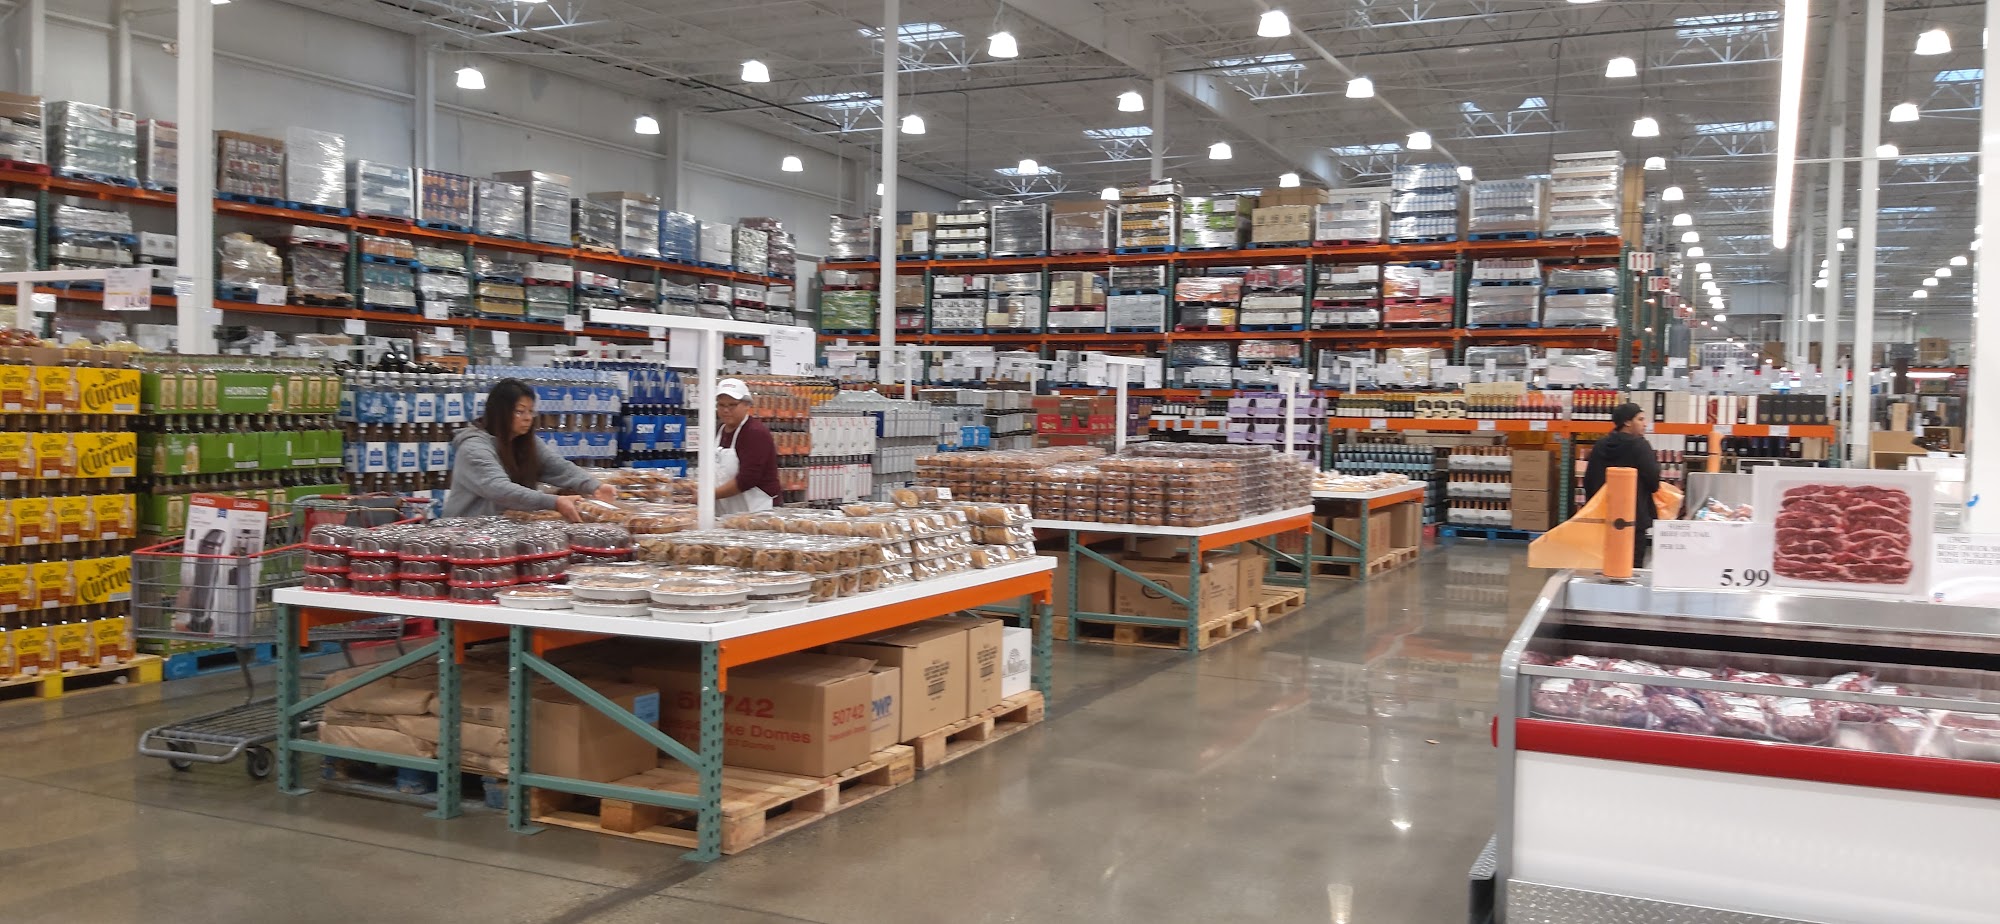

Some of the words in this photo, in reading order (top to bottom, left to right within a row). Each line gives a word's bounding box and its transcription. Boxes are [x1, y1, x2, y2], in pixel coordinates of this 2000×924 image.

[1632, 254, 1652, 268] 111
[796, 362, 816, 375] 7.99
[225, 386, 268, 396] HORNITOS
[1720, 568, 1771, 587] 5.99
[831, 703, 865, 727] 50742
[751, 724, 812, 744] Domes
